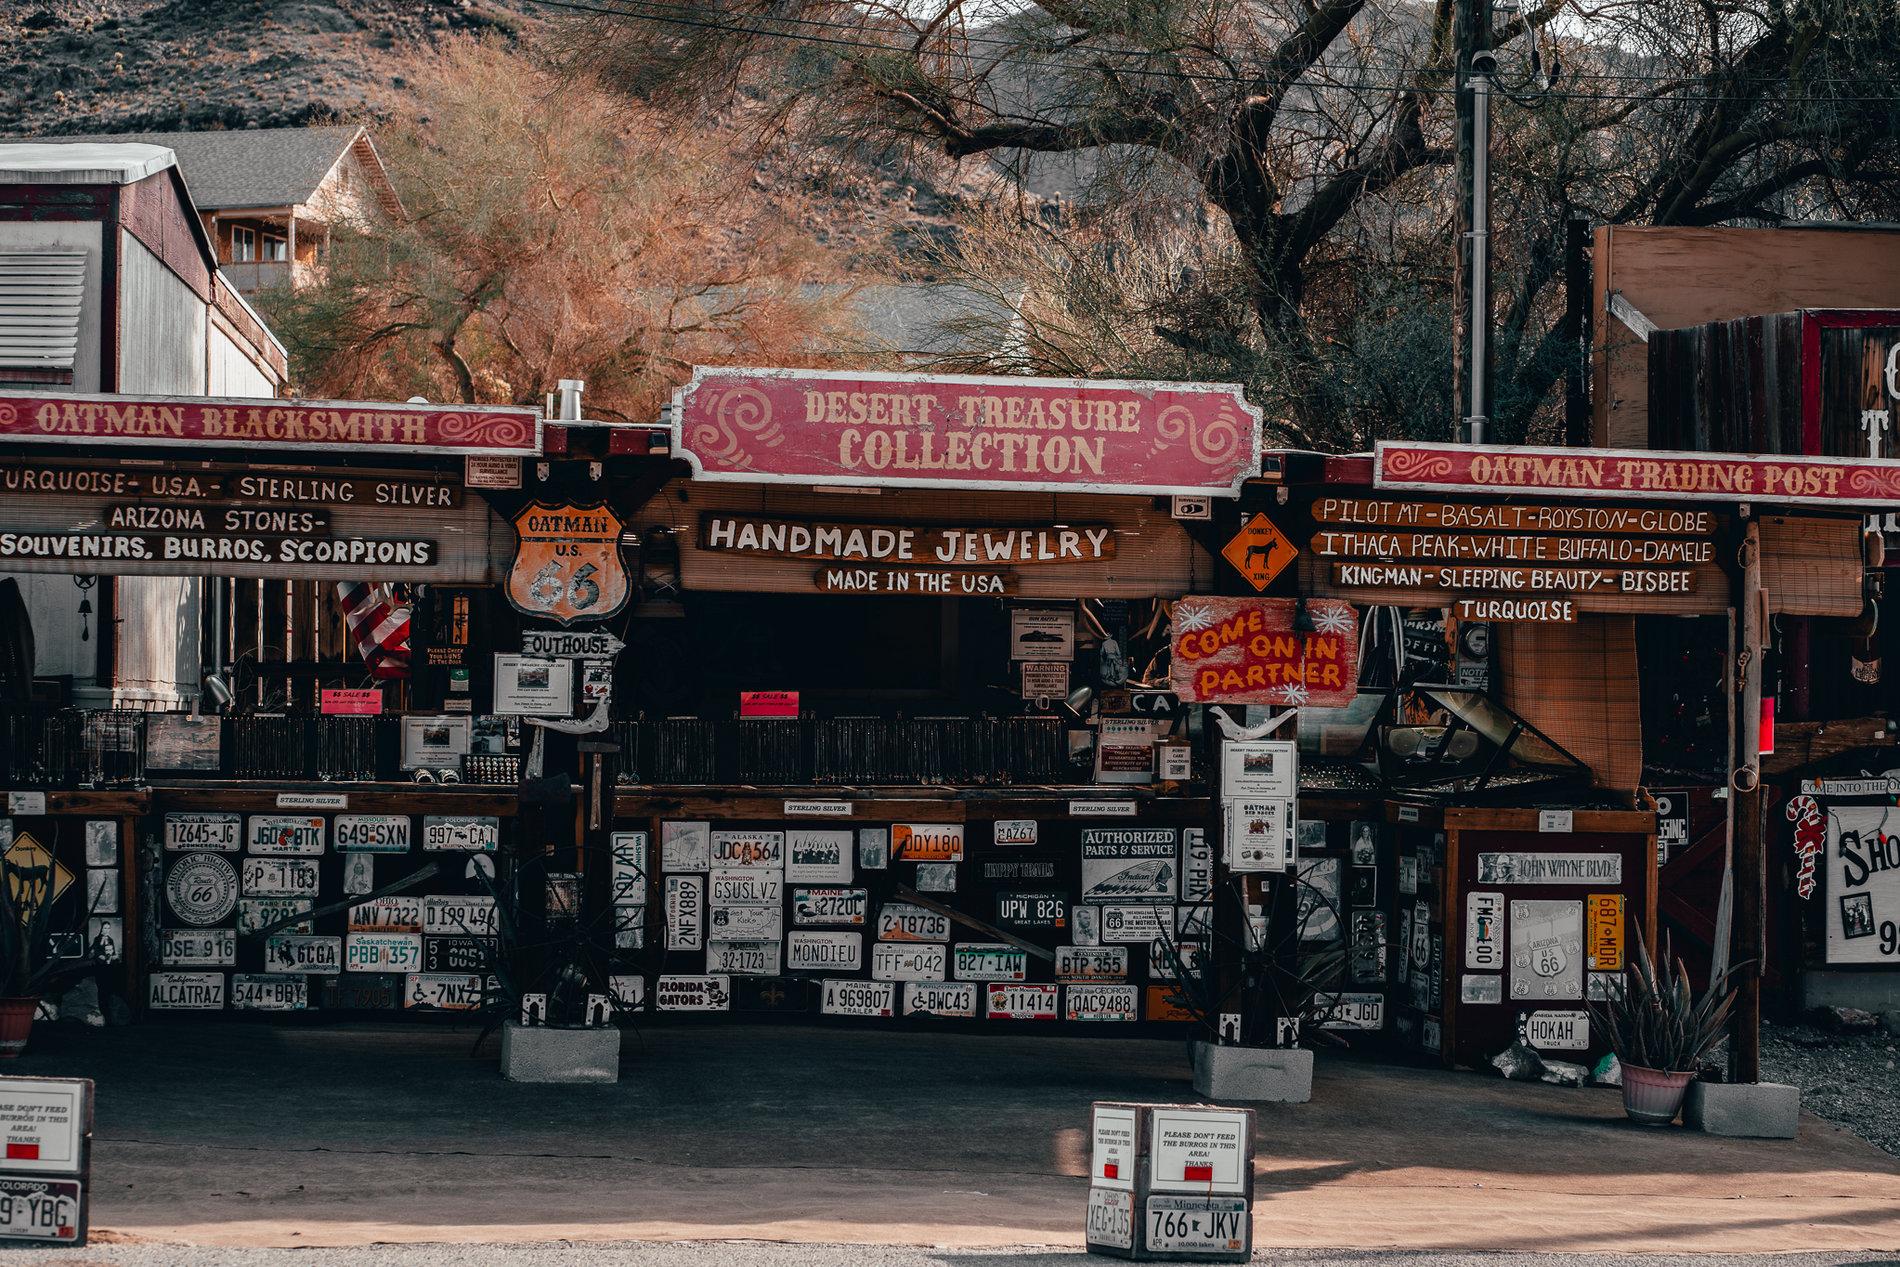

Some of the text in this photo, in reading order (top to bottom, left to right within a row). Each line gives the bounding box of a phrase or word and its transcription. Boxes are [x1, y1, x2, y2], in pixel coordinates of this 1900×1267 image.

[805, 389, 1141, 434] DESERT TREASURE
[35, 402, 428, 444] OATMAN BLACKSMITH
[838, 429, 1106, 476] COLLECTION
[1470, 454, 1845, 496] OATMAN TRADING POST
[0, 469, 452, 506] URQUOISE- STERLING SILVER
[111, 507, 205, 531] ARIZONA
[1323, 498, 1393, 523] PILOT
[528, 516, 609, 533] OATMAN
[1248, 528, 1273, 536] DONKEY
[0, 533, 430, 564] SOUVENIRS, BURROS, SCORPIONS
[709, 518, 1109, 562] HANDMADE JEWELRY
[1319, 532, 1402, 557] ITHACA
[555, 545, 582, 557] U.S.
[530, 559, 600, 610] 66
[826, 569, 1004, 594] MADE IN THE USA
[1253, 573, 1270, 581] XING
[1438, 567, 1525, 590] SLEEPING
[1621, 570, 1690, 592] BISBEE
[1459, 600, 1573, 622] TURQUOISE
[1179, 611, 1263, 660] COME
[533, 636, 609, 654] OUTHOUSE
[1250, 634, 1338, 659] ON IN
[1201, 662, 1342, 695] PARTNER
[1836, 782, 1861, 793] INTO
[1865, 782, 1886, 792] THE
[172, 824, 233, 843] 12645 JG
[338, 824, 406, 844] 649 SXN
[430, 828, 452, 843] 997
[1006, 828, 1033, 840] AZ67
[1085, 832, 1173, 844] AUTHORIZED
[714, 842, 779, 860] JDC 564
[1085, 845, 1173, 855] PARTS & SERVICE
[1118, 871, 1151, 880] Indian
[1519, 860, 1546, 877] JOHN
[1549, 860, 1585, 877] WAYNE
[255, 868, 314, 888] P 1183
[192, 887, 213, 902] 66
[714, 882, 777, 899] GSUSLVZ
[354, 907, 418, 925] ANV 7322
[427, 907, 435, 925] D
[440, 908, 464, 925] 199
[679, 881, 697, 945] 2NFX889
[1001, 901, 1064, 918] UPW 826
[1109, 918, 1121, 927] 66
[164, 940, 233, 957] DSE 916
[356, 938, 412, 946] Saskatchewan
[1416, 938, 1426, 962] 66
[1532, 937, 1559, 949] ARIZONA
[349, 946, 419, 964] PBB 357
[793, 944, 856, 962] MONDIEU
[876, 954, 942, 971] TFF 042
[1063, 957, 1120, 973] BTP 355
[1541, 957, 1559, 973] 66
[152, 985, 220, 1003] ALCATRAZ
[236, 984, 302, 1002] 544 BBY
[660, 982, 703, 992] FLORIDA
[660, 995, 703, 1005] GATORS
[827, 989, 890, 1008] A 969807
[928, 992, 970, 1010] BWC43
[1010, 994, 1053, 1010] 11414
[1073, 996, 1130, 1012] QAC9488
[1354, 1004, 1379, 1020] JGD
[1531, 1021, 1573, 1039] HOKAH
[17, 1104, 42, 1113] DON'T
[0, 1115, 34, 1123] BURROS
[1174, 1200, 1219, 1208] Minnesota
[1152, 1212, 1240, 1239] 766 JKV
